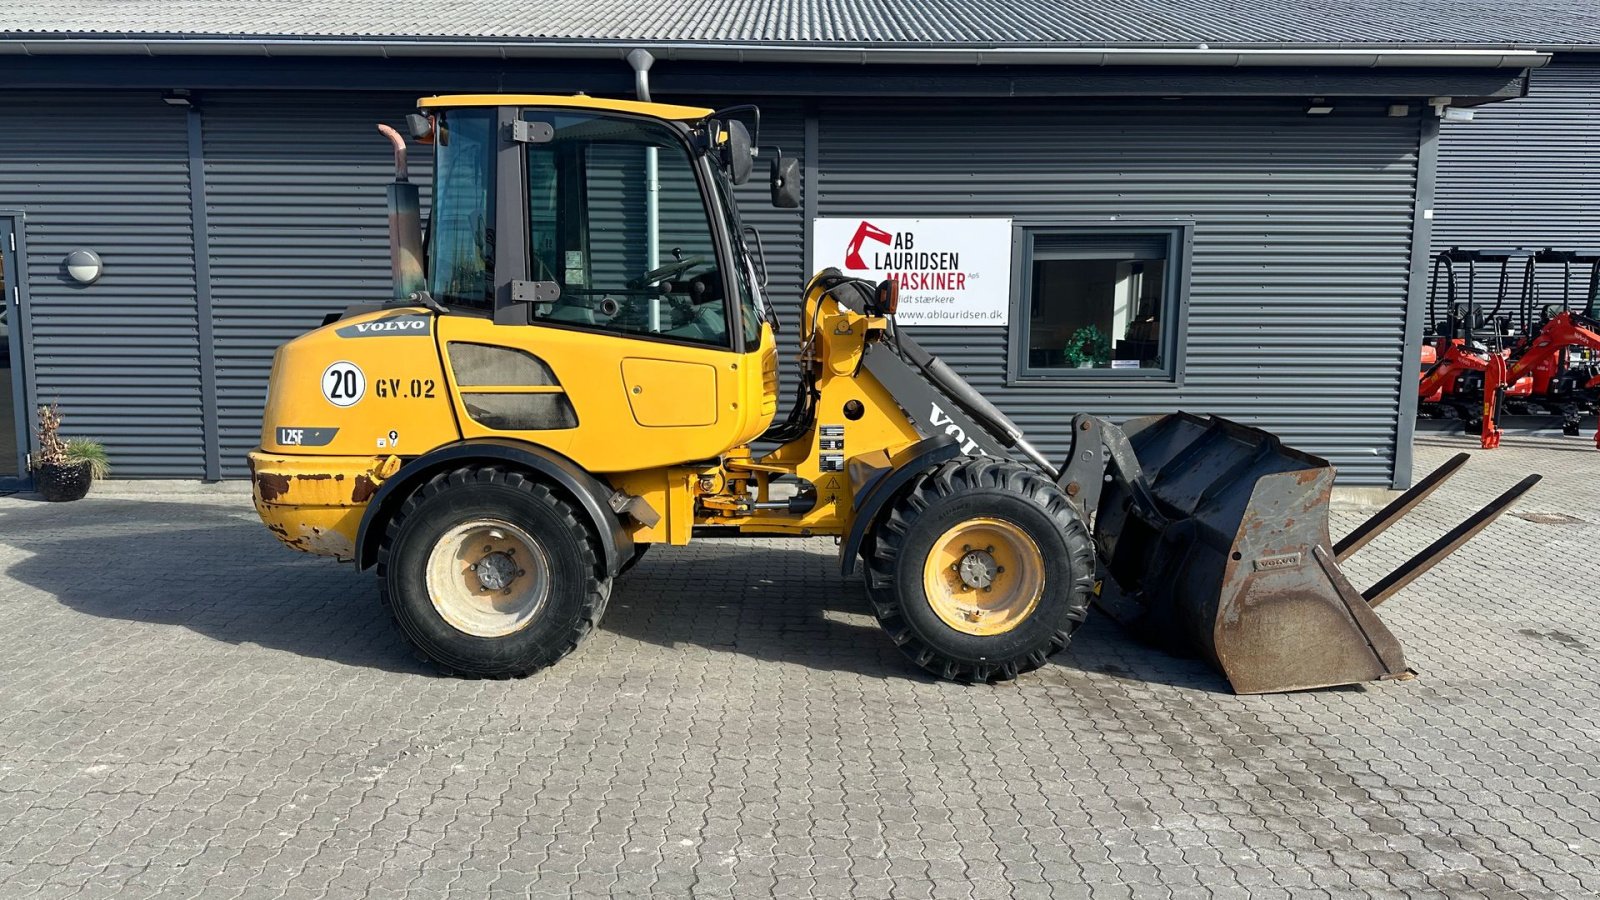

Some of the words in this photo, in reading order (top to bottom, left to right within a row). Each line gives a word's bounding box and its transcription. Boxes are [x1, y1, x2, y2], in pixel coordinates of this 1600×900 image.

[894, 232, 914, 250] AB
[875, 252, 959, 270] LAURIDSEN
[968, 272, 980, 280] ApS
[914, 295, 955, 304] stærkere
[898, 310, 1003, 320] www.ablauridsen.dk
[355, 321, 425, 333] VOLVO
[330, 370, 357, 399] 20
[376, 379, 435, 399] GV.02
[282, 429, 304, 445] L25F
[1259, 557, 1296, 567] VOLVO
